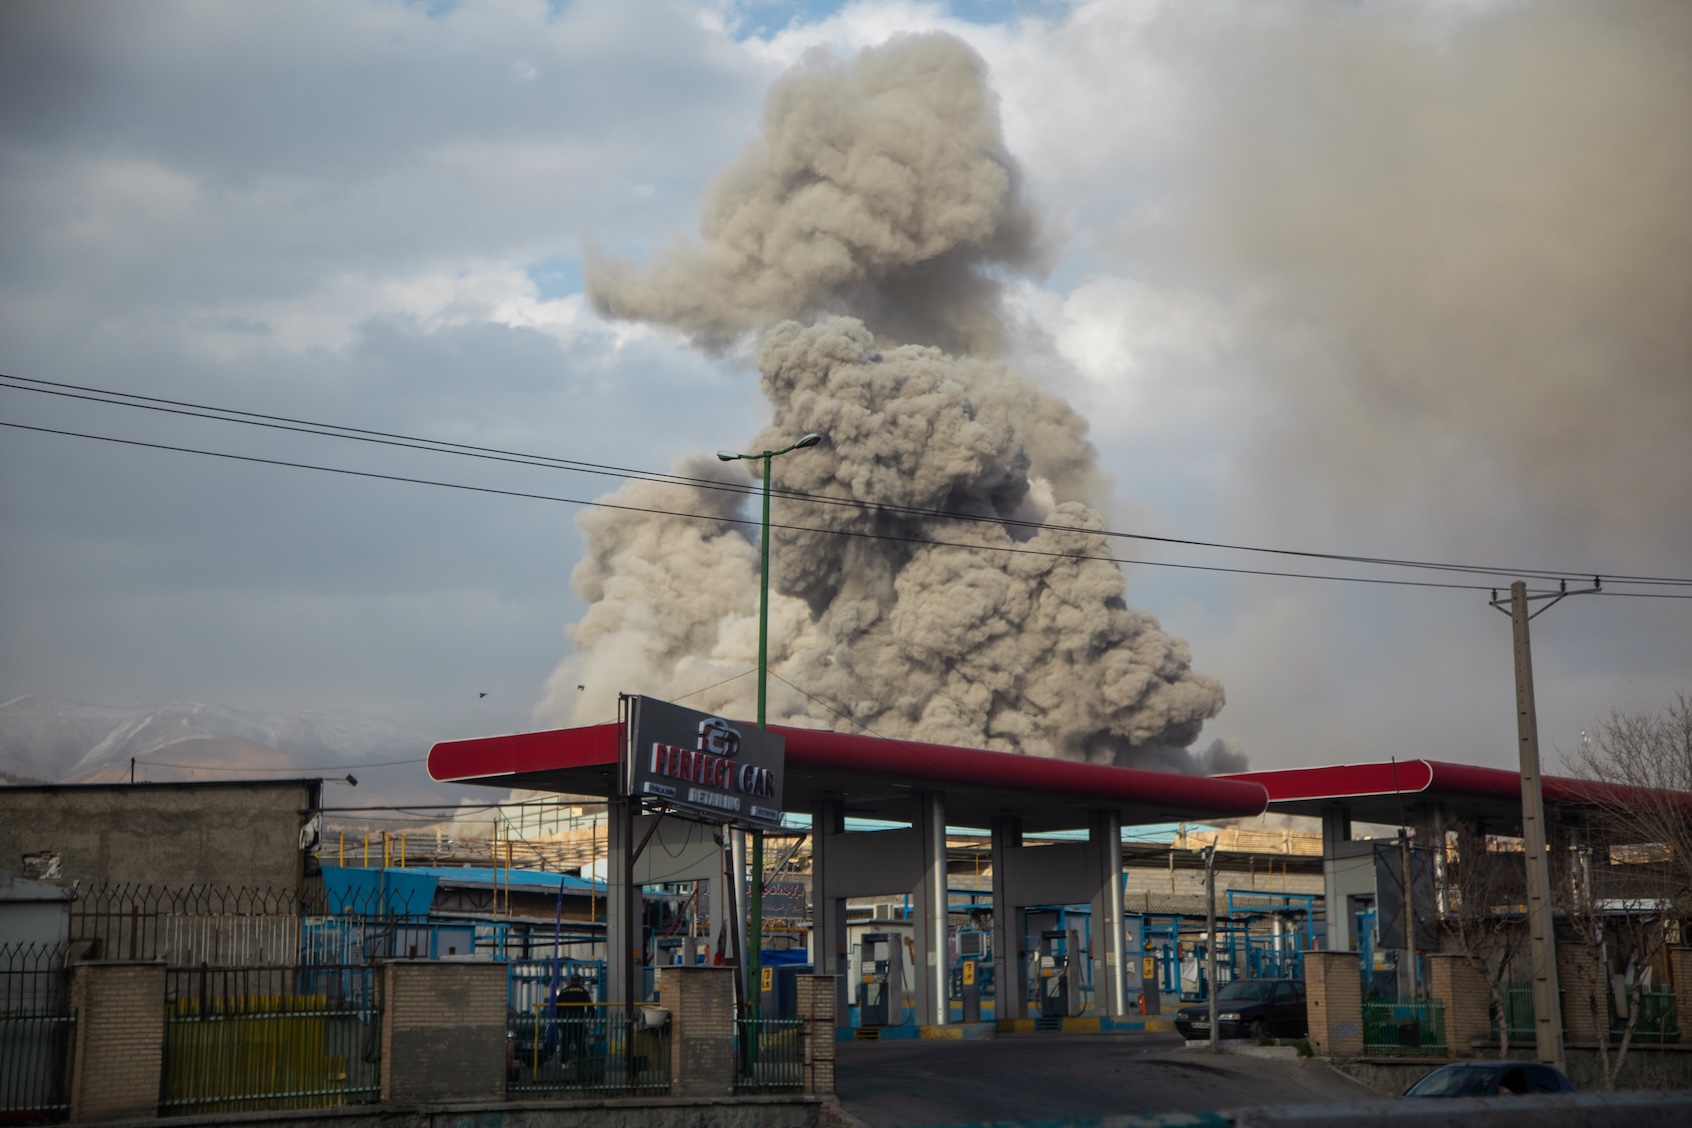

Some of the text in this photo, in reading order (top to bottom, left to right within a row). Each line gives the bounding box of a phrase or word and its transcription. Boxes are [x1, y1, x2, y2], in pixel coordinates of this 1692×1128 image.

[651, 742, 775, 799] PERFECT CAR
[688, 788, 740, 811] DETAILING
